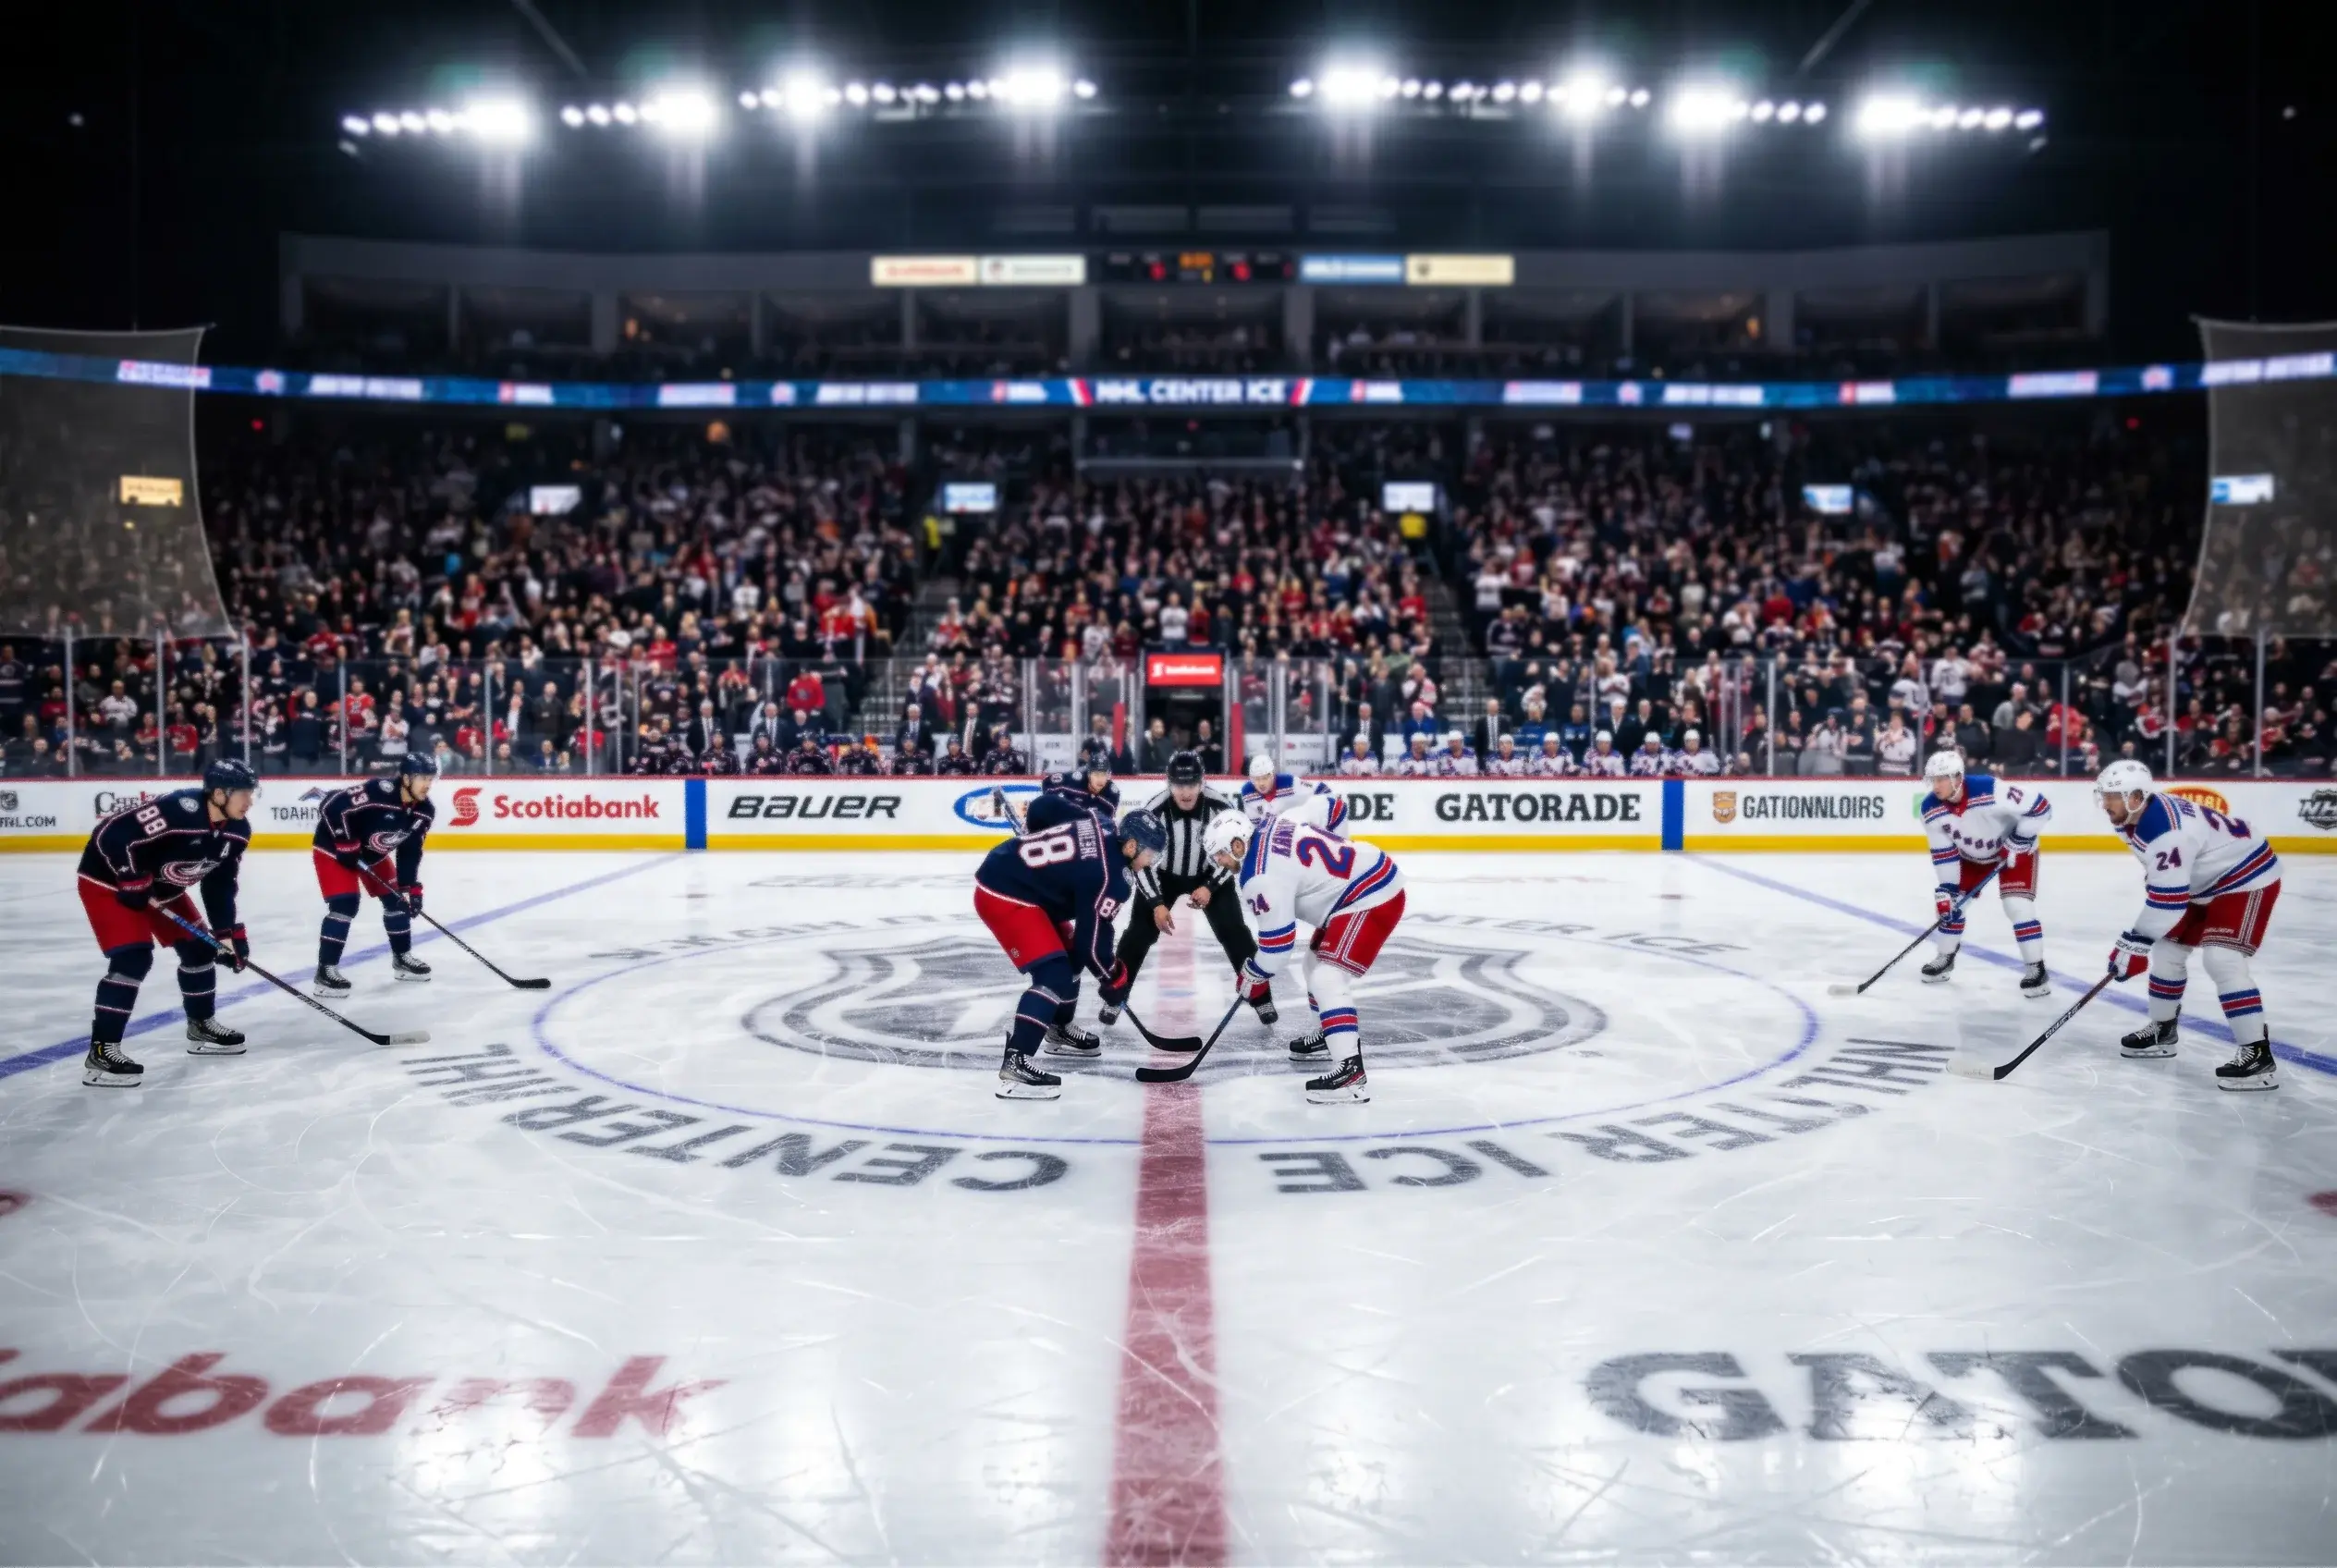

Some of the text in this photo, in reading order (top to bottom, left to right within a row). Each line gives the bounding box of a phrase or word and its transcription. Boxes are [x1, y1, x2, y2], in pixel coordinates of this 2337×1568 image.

[1149, 379, 1242, 405] CENTER
[1246, 379, 1286, 405] ICE
[494, 793, 660, 819] Scotiabank
[727, 795, 902, 819] BAUER
[1434, 792, 1641, 822] GATORADE
[2156, 846, 2182, 871] 24
[499, 1094, 1070, 1192] CENTER
[1258, 1139, 1551, 1194] ICE
[0, 1348, 731, 1438] abank
